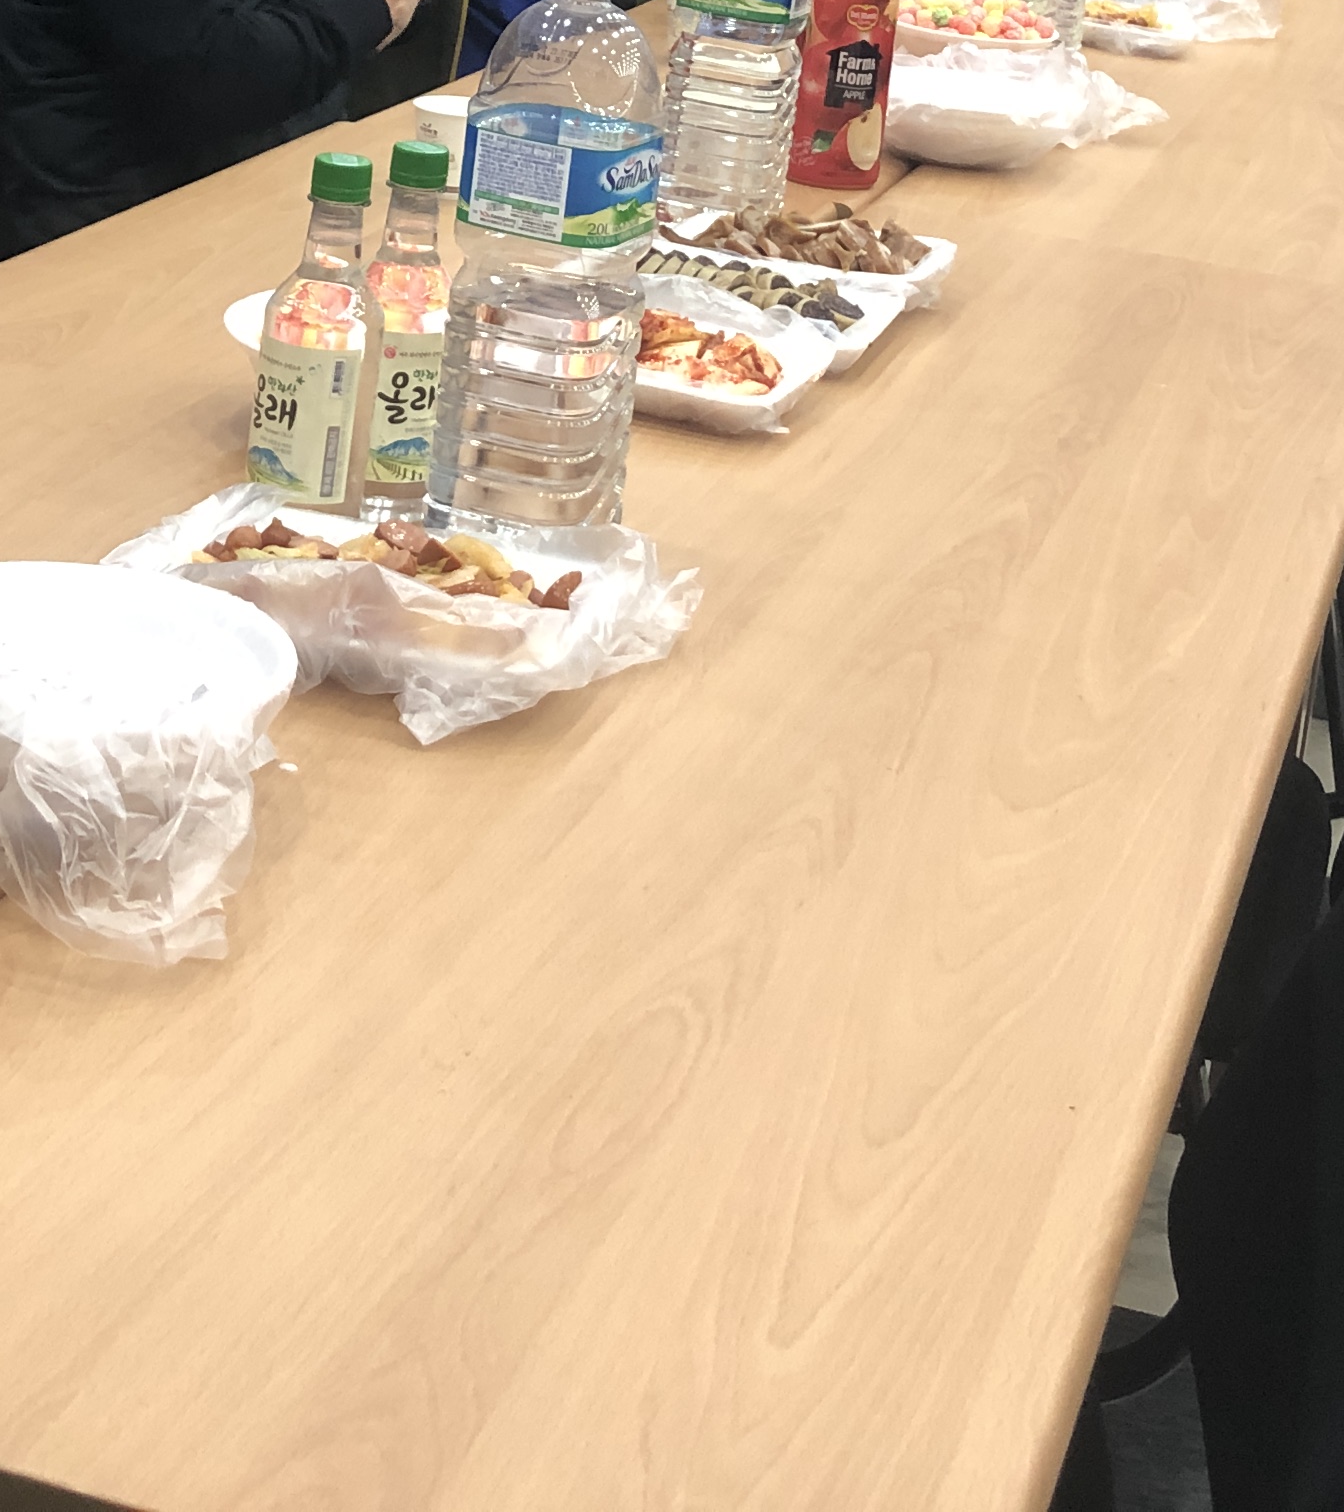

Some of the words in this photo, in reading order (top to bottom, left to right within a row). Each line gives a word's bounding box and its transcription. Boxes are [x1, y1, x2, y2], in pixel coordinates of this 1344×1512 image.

[836, 68, 873, 86] Home
[843, 90, 866, 100] APPLE
[253, 373, 298, 431] 올래
